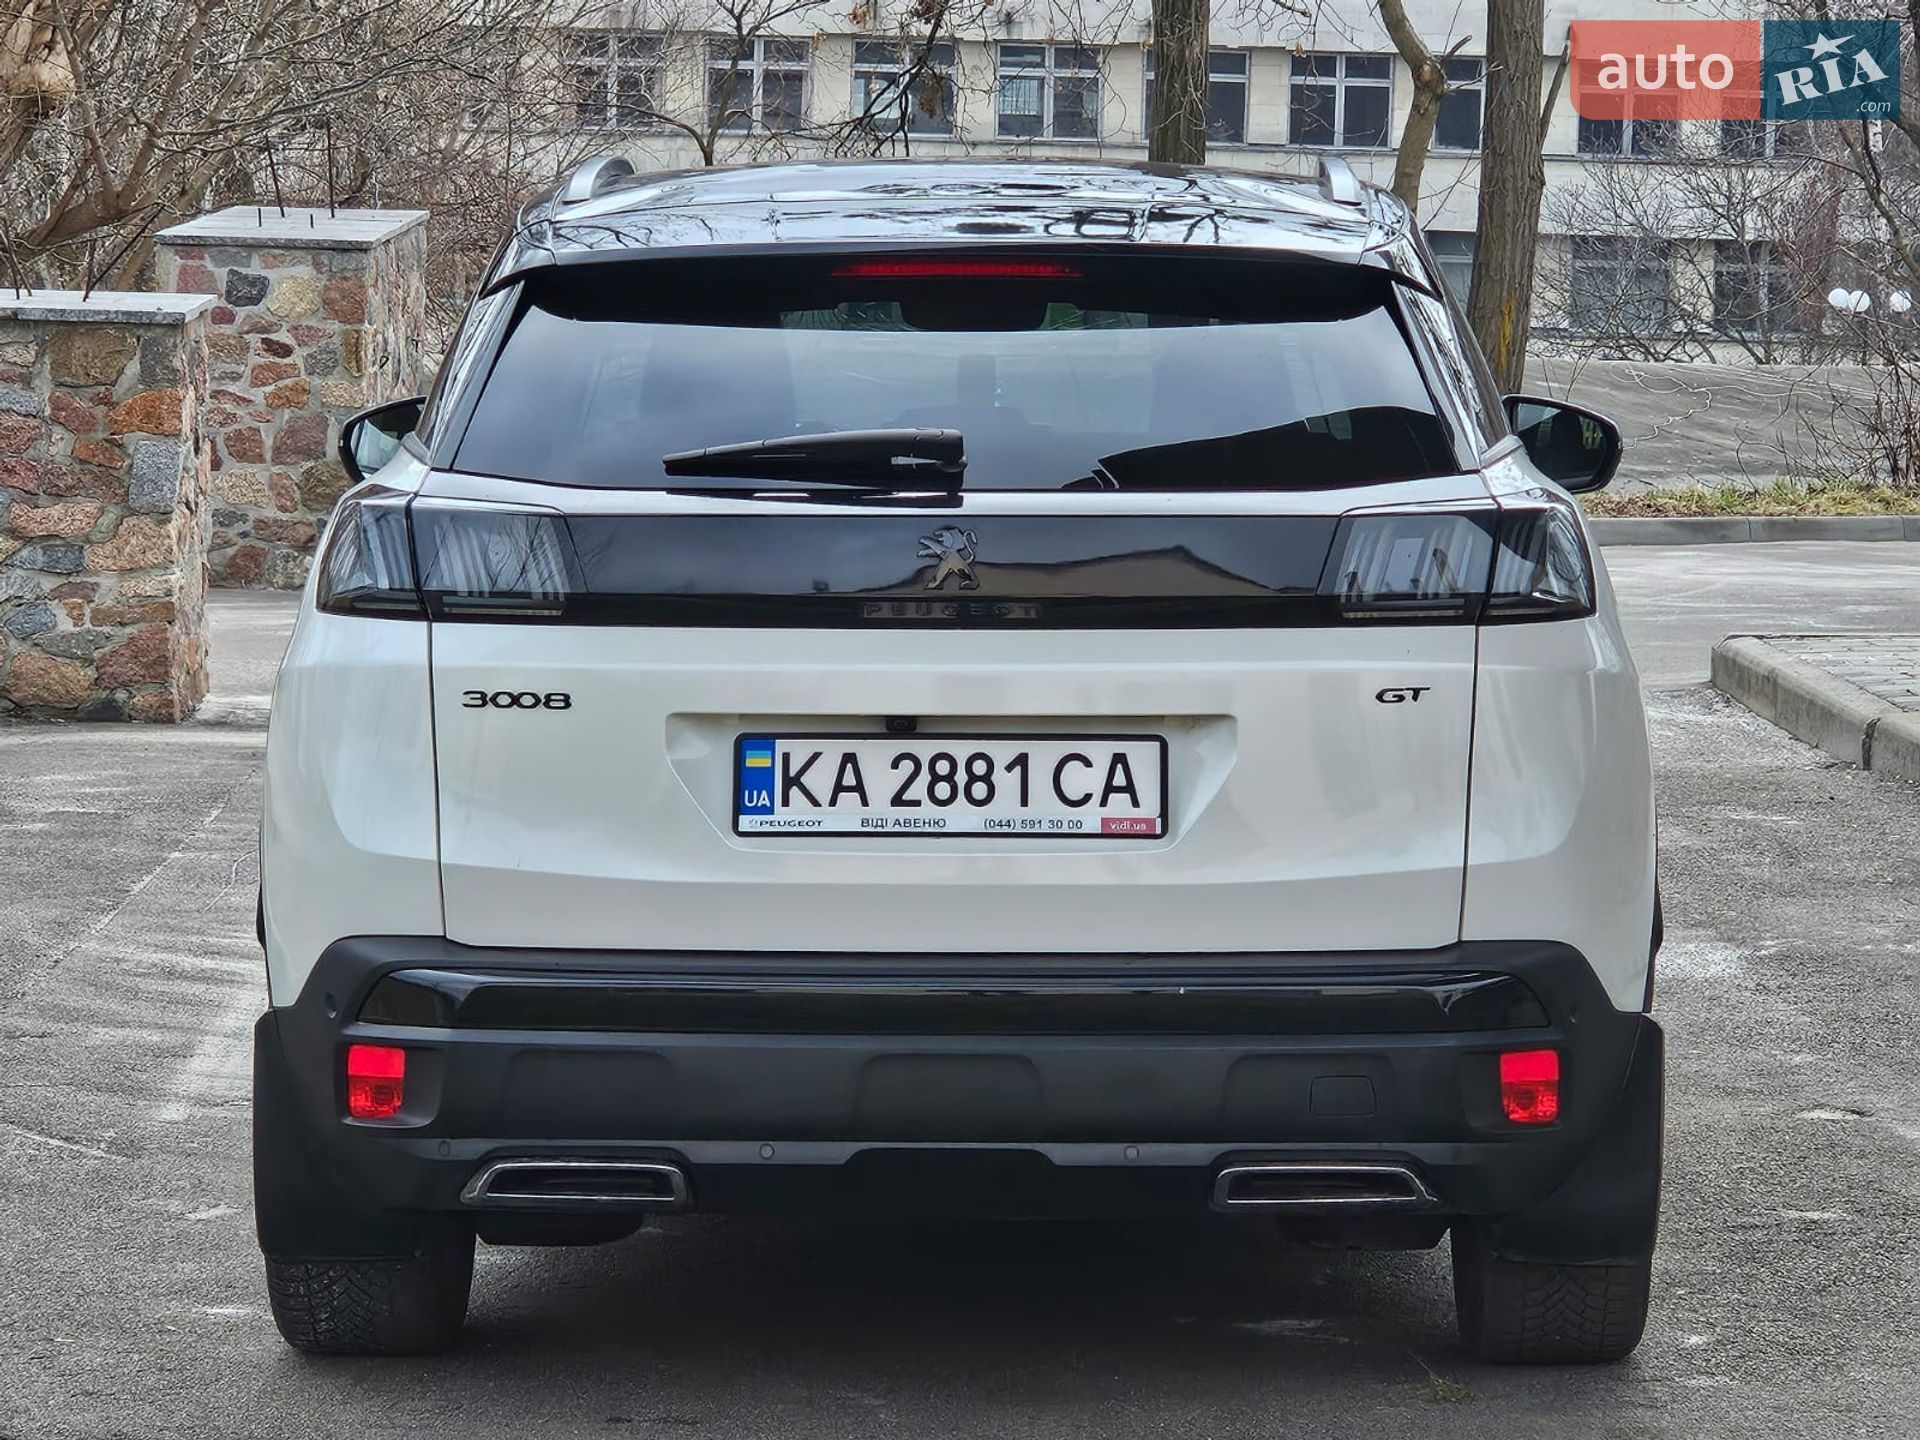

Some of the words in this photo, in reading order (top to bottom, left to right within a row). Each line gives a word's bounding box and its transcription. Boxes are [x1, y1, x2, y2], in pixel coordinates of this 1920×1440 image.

[865, 603, 1037, 617] PEUGEOT
[462, 690, 572, 710] 3008
[1375, 687, 1431, 703] GT
[781, 752, 869, 808] KA
[890, 752, 1030, 809] 2881
[1052, 752, 1141, 809] CA
[744, 790, 770, 808] UA
[759, 819, 824, 828] PEUGEOT
[892, 818, 946, 829] АВЕНЮ
[983, 818, 1017, 830] (044)
[1021, 818, 1042, 830] 591
[1048, 819, 1063, 830] 30
[1067, 819, 1083, 830] 00
